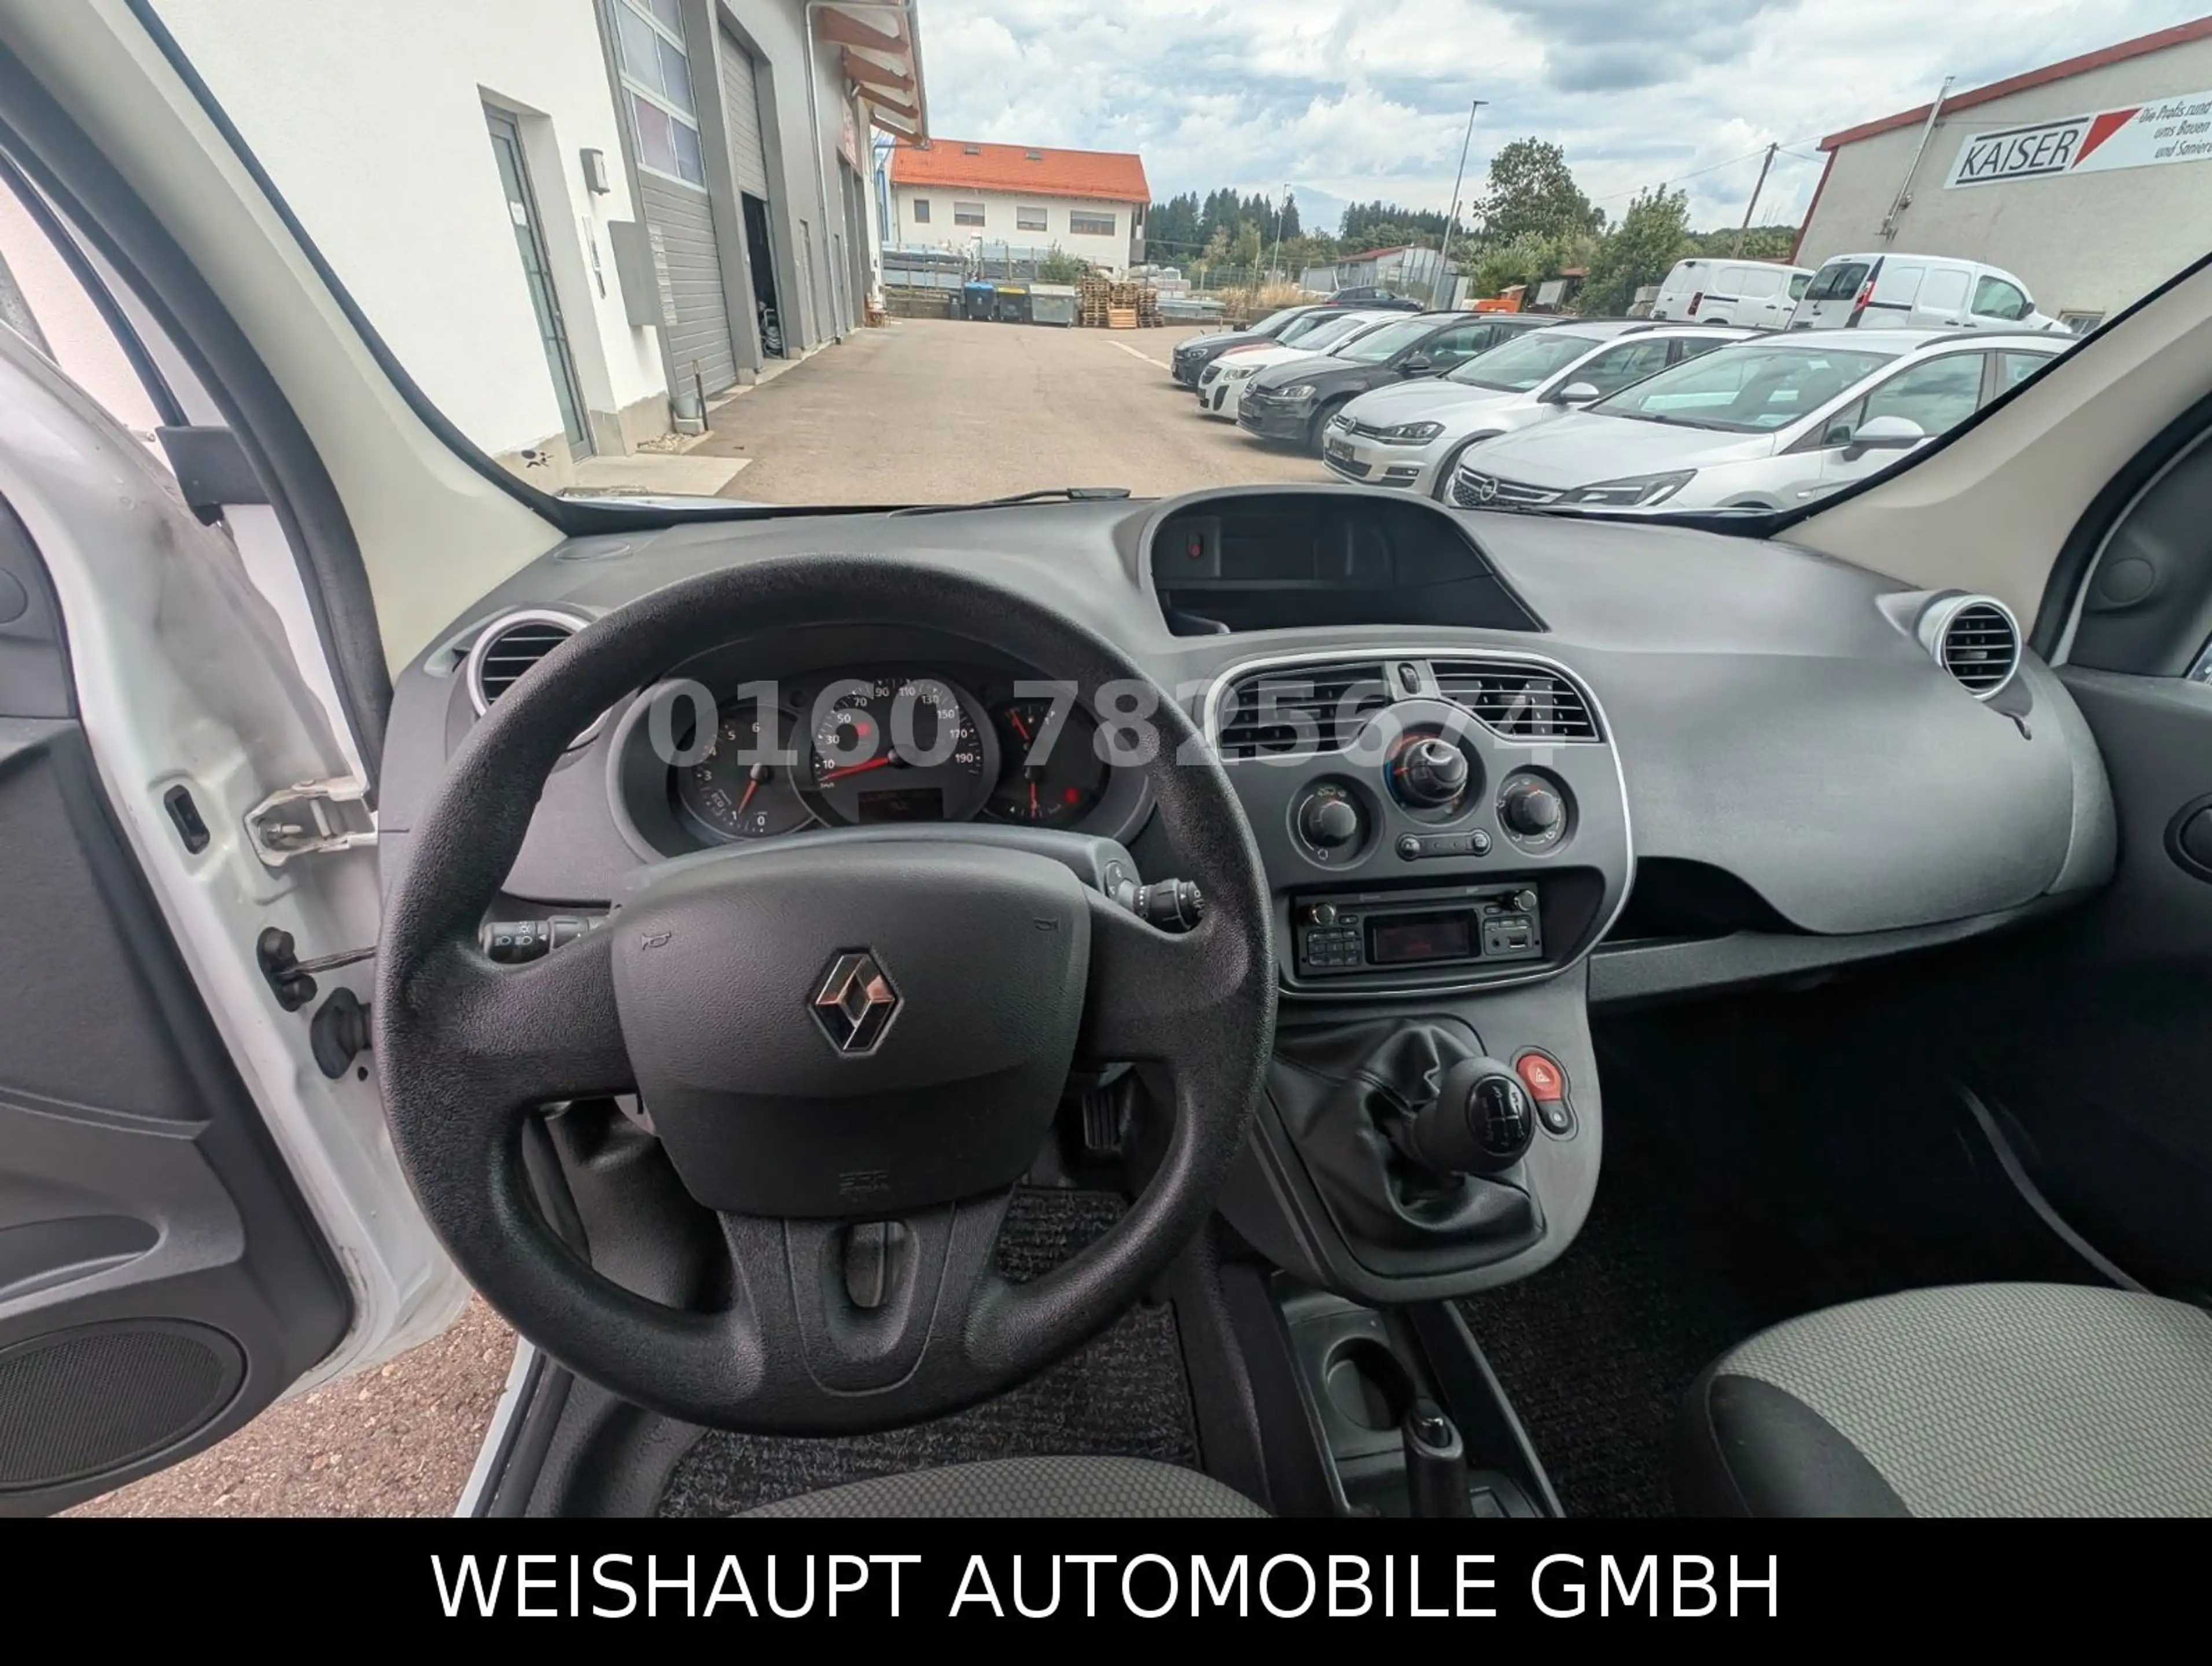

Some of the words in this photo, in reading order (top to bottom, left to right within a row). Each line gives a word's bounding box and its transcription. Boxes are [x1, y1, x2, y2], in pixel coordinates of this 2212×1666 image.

[2139, 106, 2156, 123] Die
[2156, 101, 2186, 120] Profis
[2154, 126, 2177, 139] ums
[2176, 120, 2211, 136] Bauen
[1958, 128, 2079, 178] KAISER
[2154, 139, 2179, 159] und
[875, 687, 889, 697] 90
[899, 687, 916, 696] 110
[854, 698, 868, 707] 70
[922, 695, 940, 705] 130
[837, 713, 851, 723] 50
[937, 709, 955, 719] 150
[752, 723, 761, 733] 6
[949, 728, 967, 738] 170
[727, 731, 736, 740] 5
[826, 735, 840, 744] 30
[955, 753, 973, 763] 190
[823, 759, 835, 769] 10
[703, 770, 712, 781] 3
[731, 810, 738, 820] 1
[757, 816, 765, 826] 0
